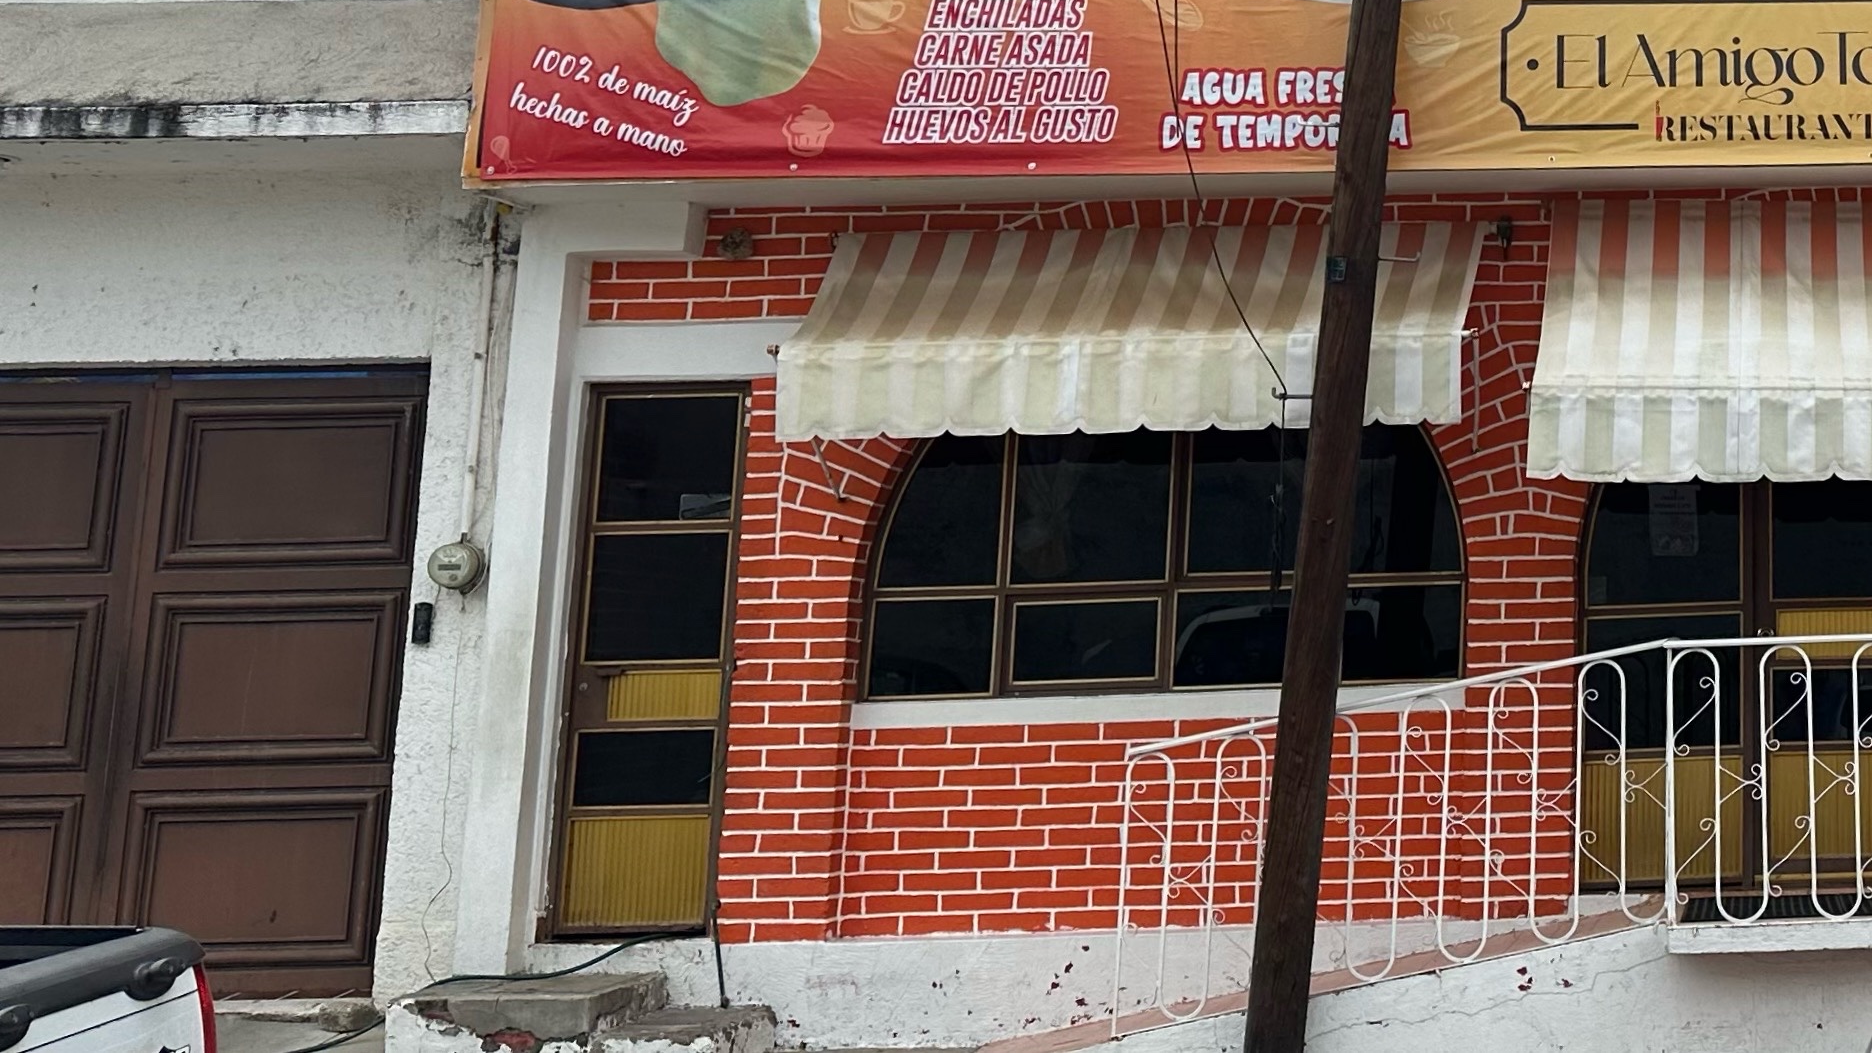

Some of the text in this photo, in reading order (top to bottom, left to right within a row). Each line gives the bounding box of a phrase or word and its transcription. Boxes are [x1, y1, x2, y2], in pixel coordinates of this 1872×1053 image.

[916, 32, 1091, 66] CARNE ASADA
[899, 69, 1108, 105] CALDO DE POLLO
[1181, 70, 1346, 105] AGUA FRES
[1556, 33, 1612, 89] El
[1621, 33, 1825, 106] Amigo
[598, 65, 630, 95] de
[633, 81, 700, 127] maíz
[510, 82, 688, 157] hechas a mano
[885, 107, 1117, 143] HUEVOS AL GUSTO
[1162, 115, 1204, 149] DE
